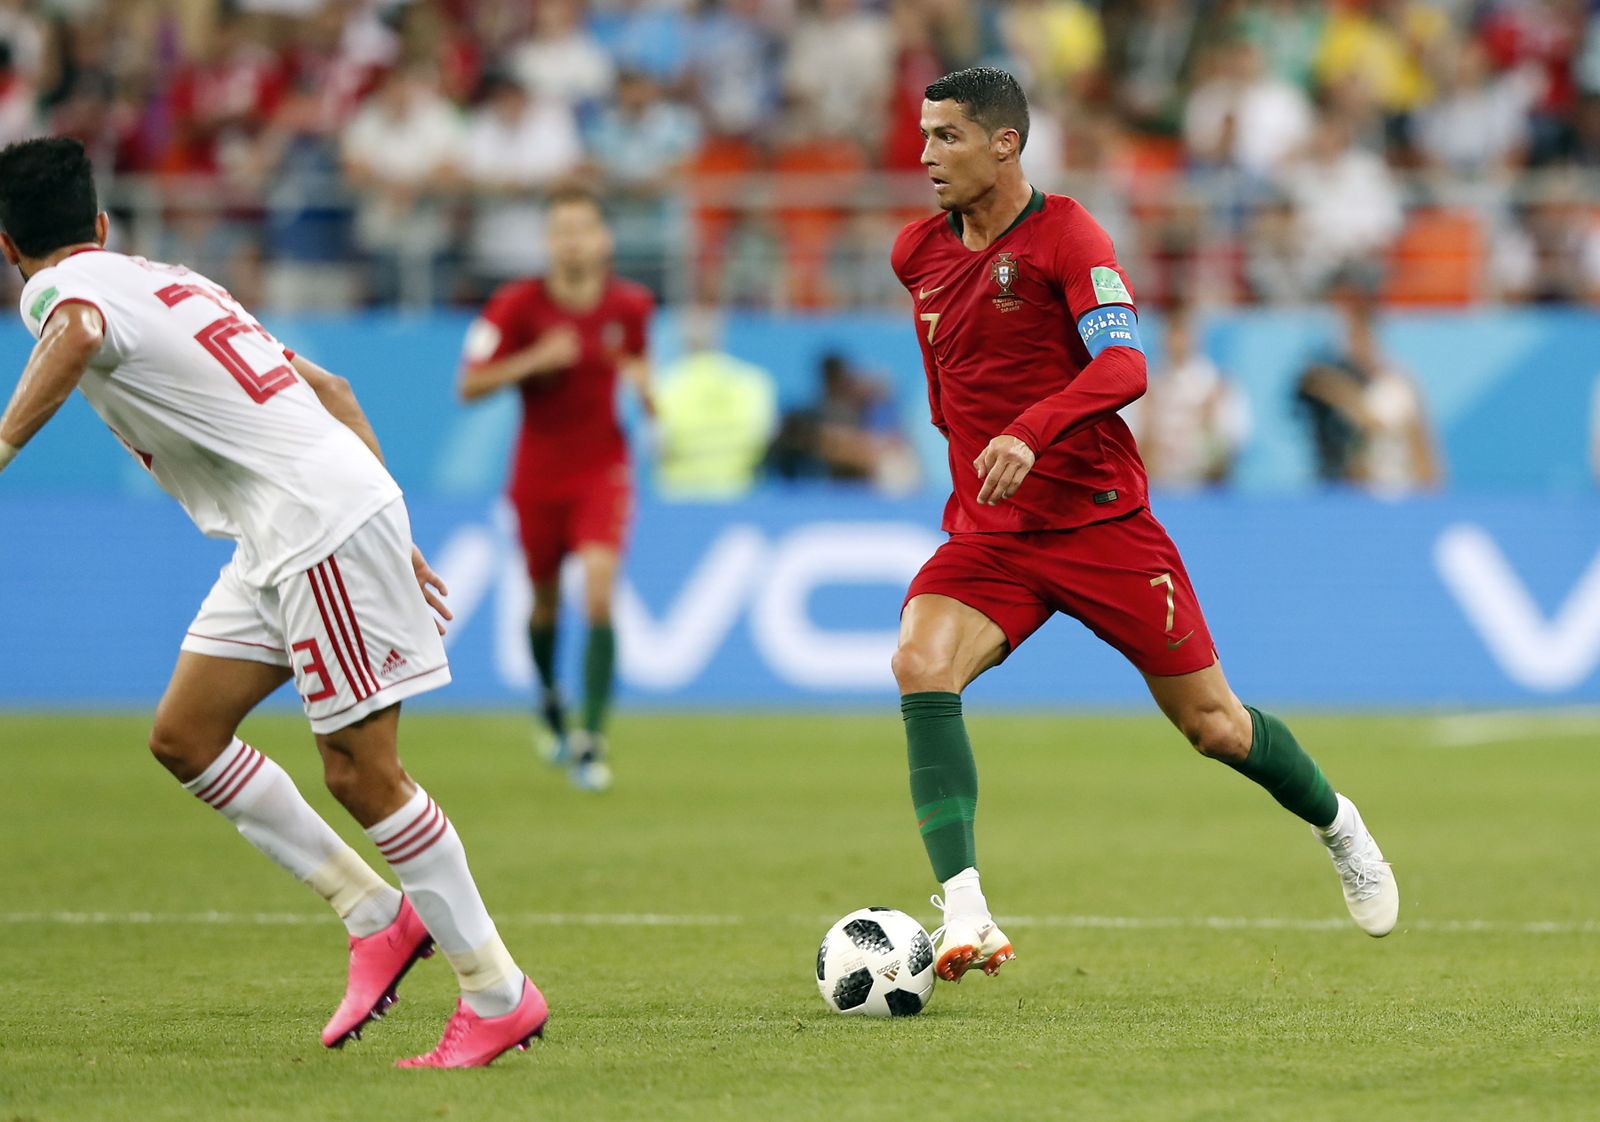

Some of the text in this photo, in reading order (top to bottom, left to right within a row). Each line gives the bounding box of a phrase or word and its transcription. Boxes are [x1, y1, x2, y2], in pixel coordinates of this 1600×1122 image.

[920, 312, 940, 345] 7
[1082, 312, 1128, 333] IVING
[1083, 319, 1129, 341] OOTBALL
[1110, 331, 1132, 340] FIFA
[1149, 572, 1175, 633] 7
[291, 637, 338, 703] 3
[876, 959, 902, 975] adidas
